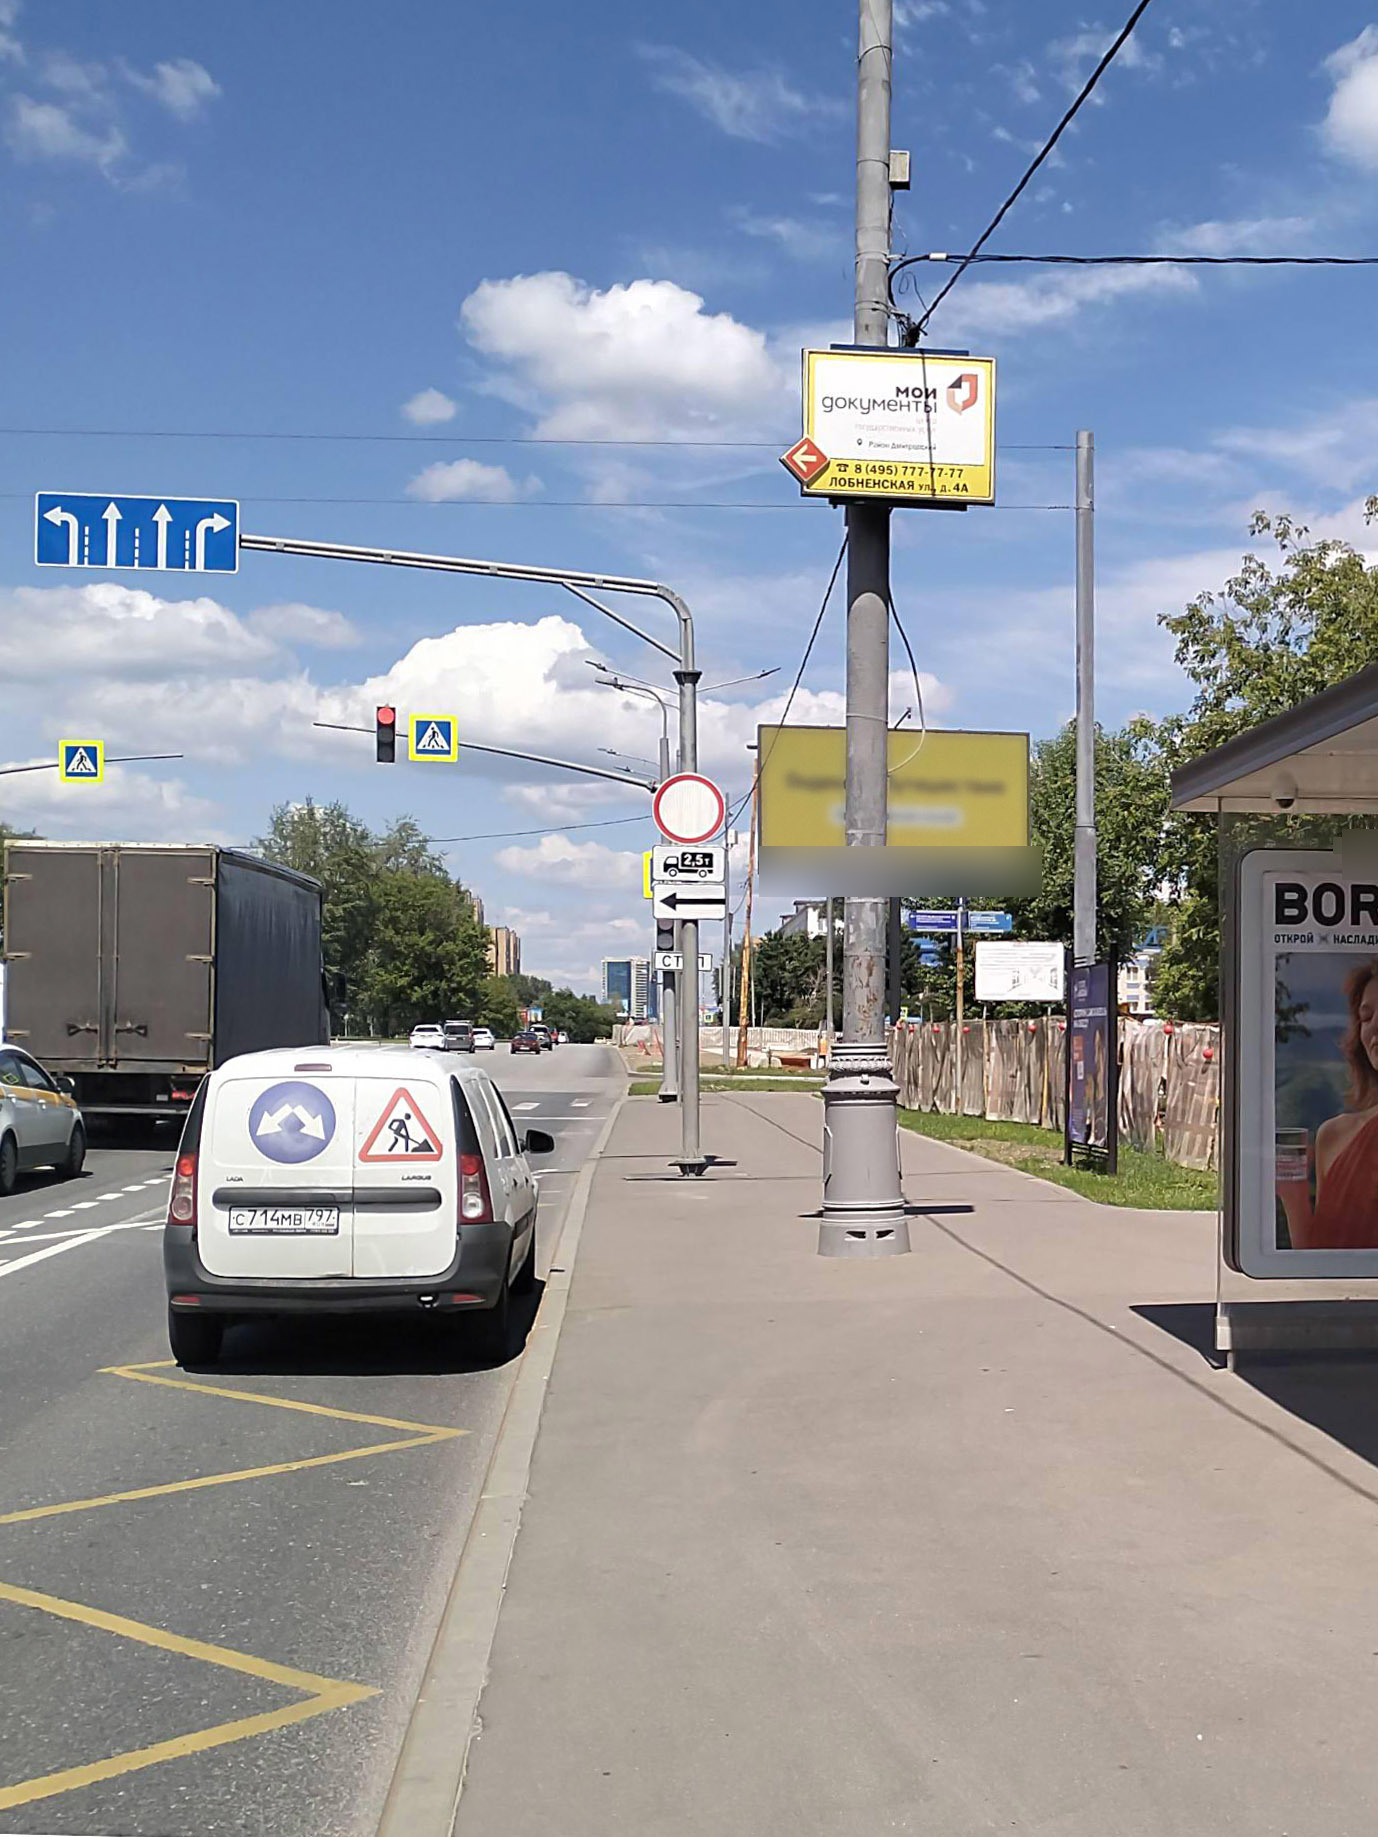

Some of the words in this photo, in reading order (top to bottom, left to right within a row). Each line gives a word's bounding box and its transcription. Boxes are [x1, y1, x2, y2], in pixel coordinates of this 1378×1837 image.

[821, 395, 937, 415] документы
[854, 464, 862, 474] 8
[865, 464, 898, 476] (495)
[902, 466, 964, 479] 777-77-77
[829, 477, 915, 491] ЛОБНЕНСКАЯ
[1274, 932, 1314, 944] ОТКРОЙ
[662, 955, 705, 968] СТП
